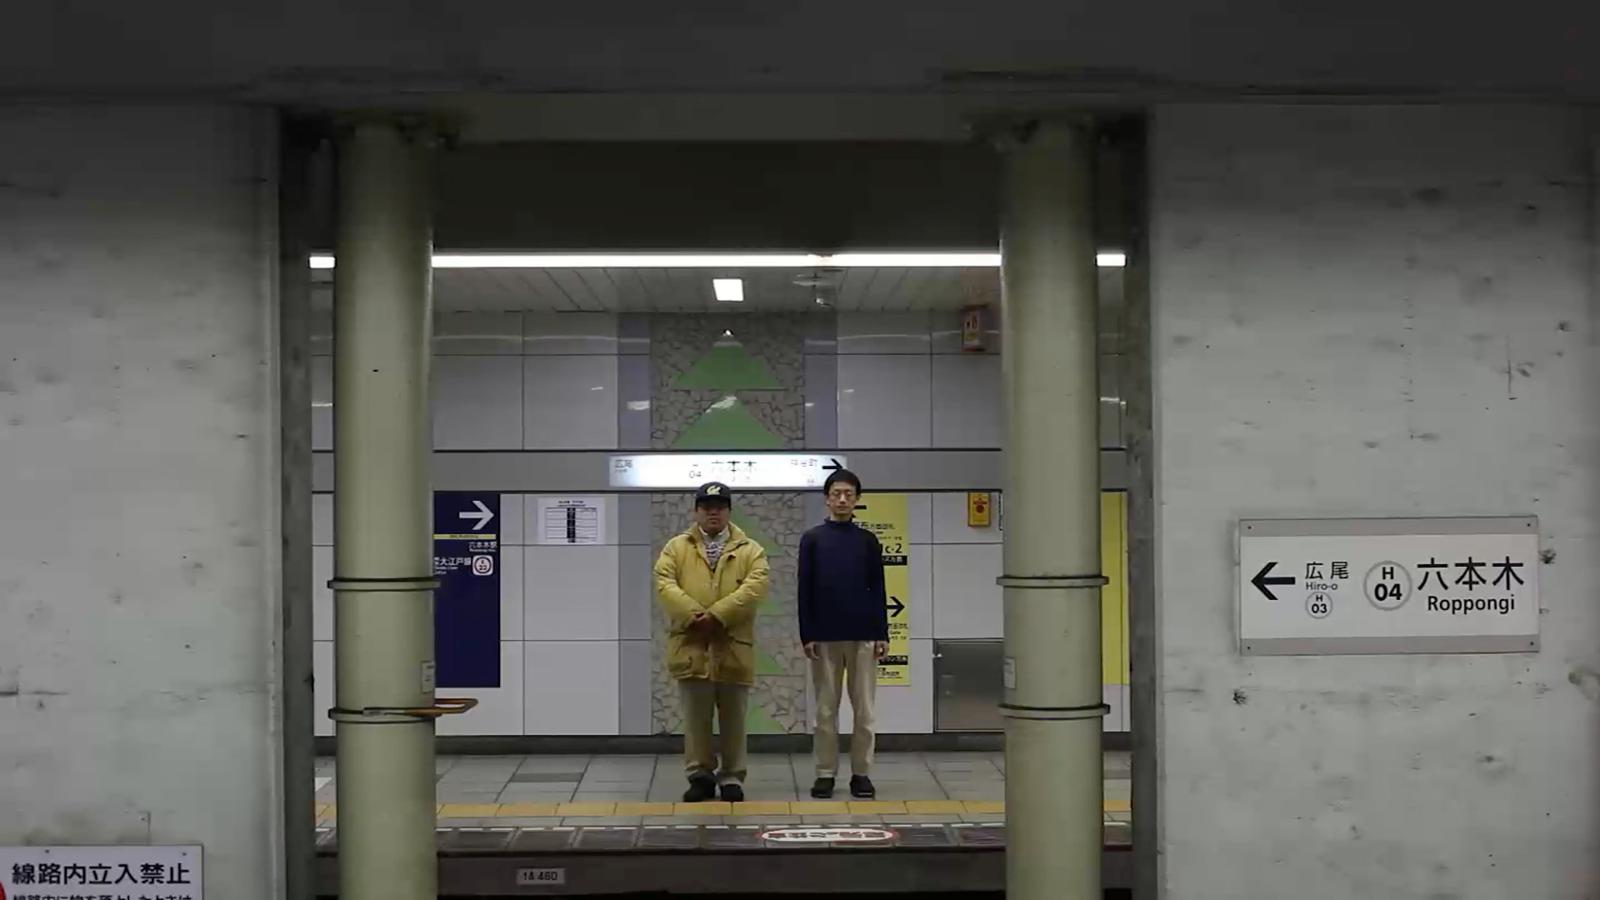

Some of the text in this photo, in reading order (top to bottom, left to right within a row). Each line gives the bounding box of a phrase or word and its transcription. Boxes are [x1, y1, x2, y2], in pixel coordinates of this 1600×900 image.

[1305, 561, 1349, 580] 広尾
[1382, 567, 1394, 580] H
[1417, 556, 1525, 592] 六本木
[1305, 581, 1338, 591] Hiro-o
[1374, 583, 1403, 602] 04
[1315, 594, 1323, 602] H
[1427, 595, 1515, 615] Roppongi
[1311, 603, 1328, 614] 03
[12, 863, 191, 885] 線路内立入禁止
